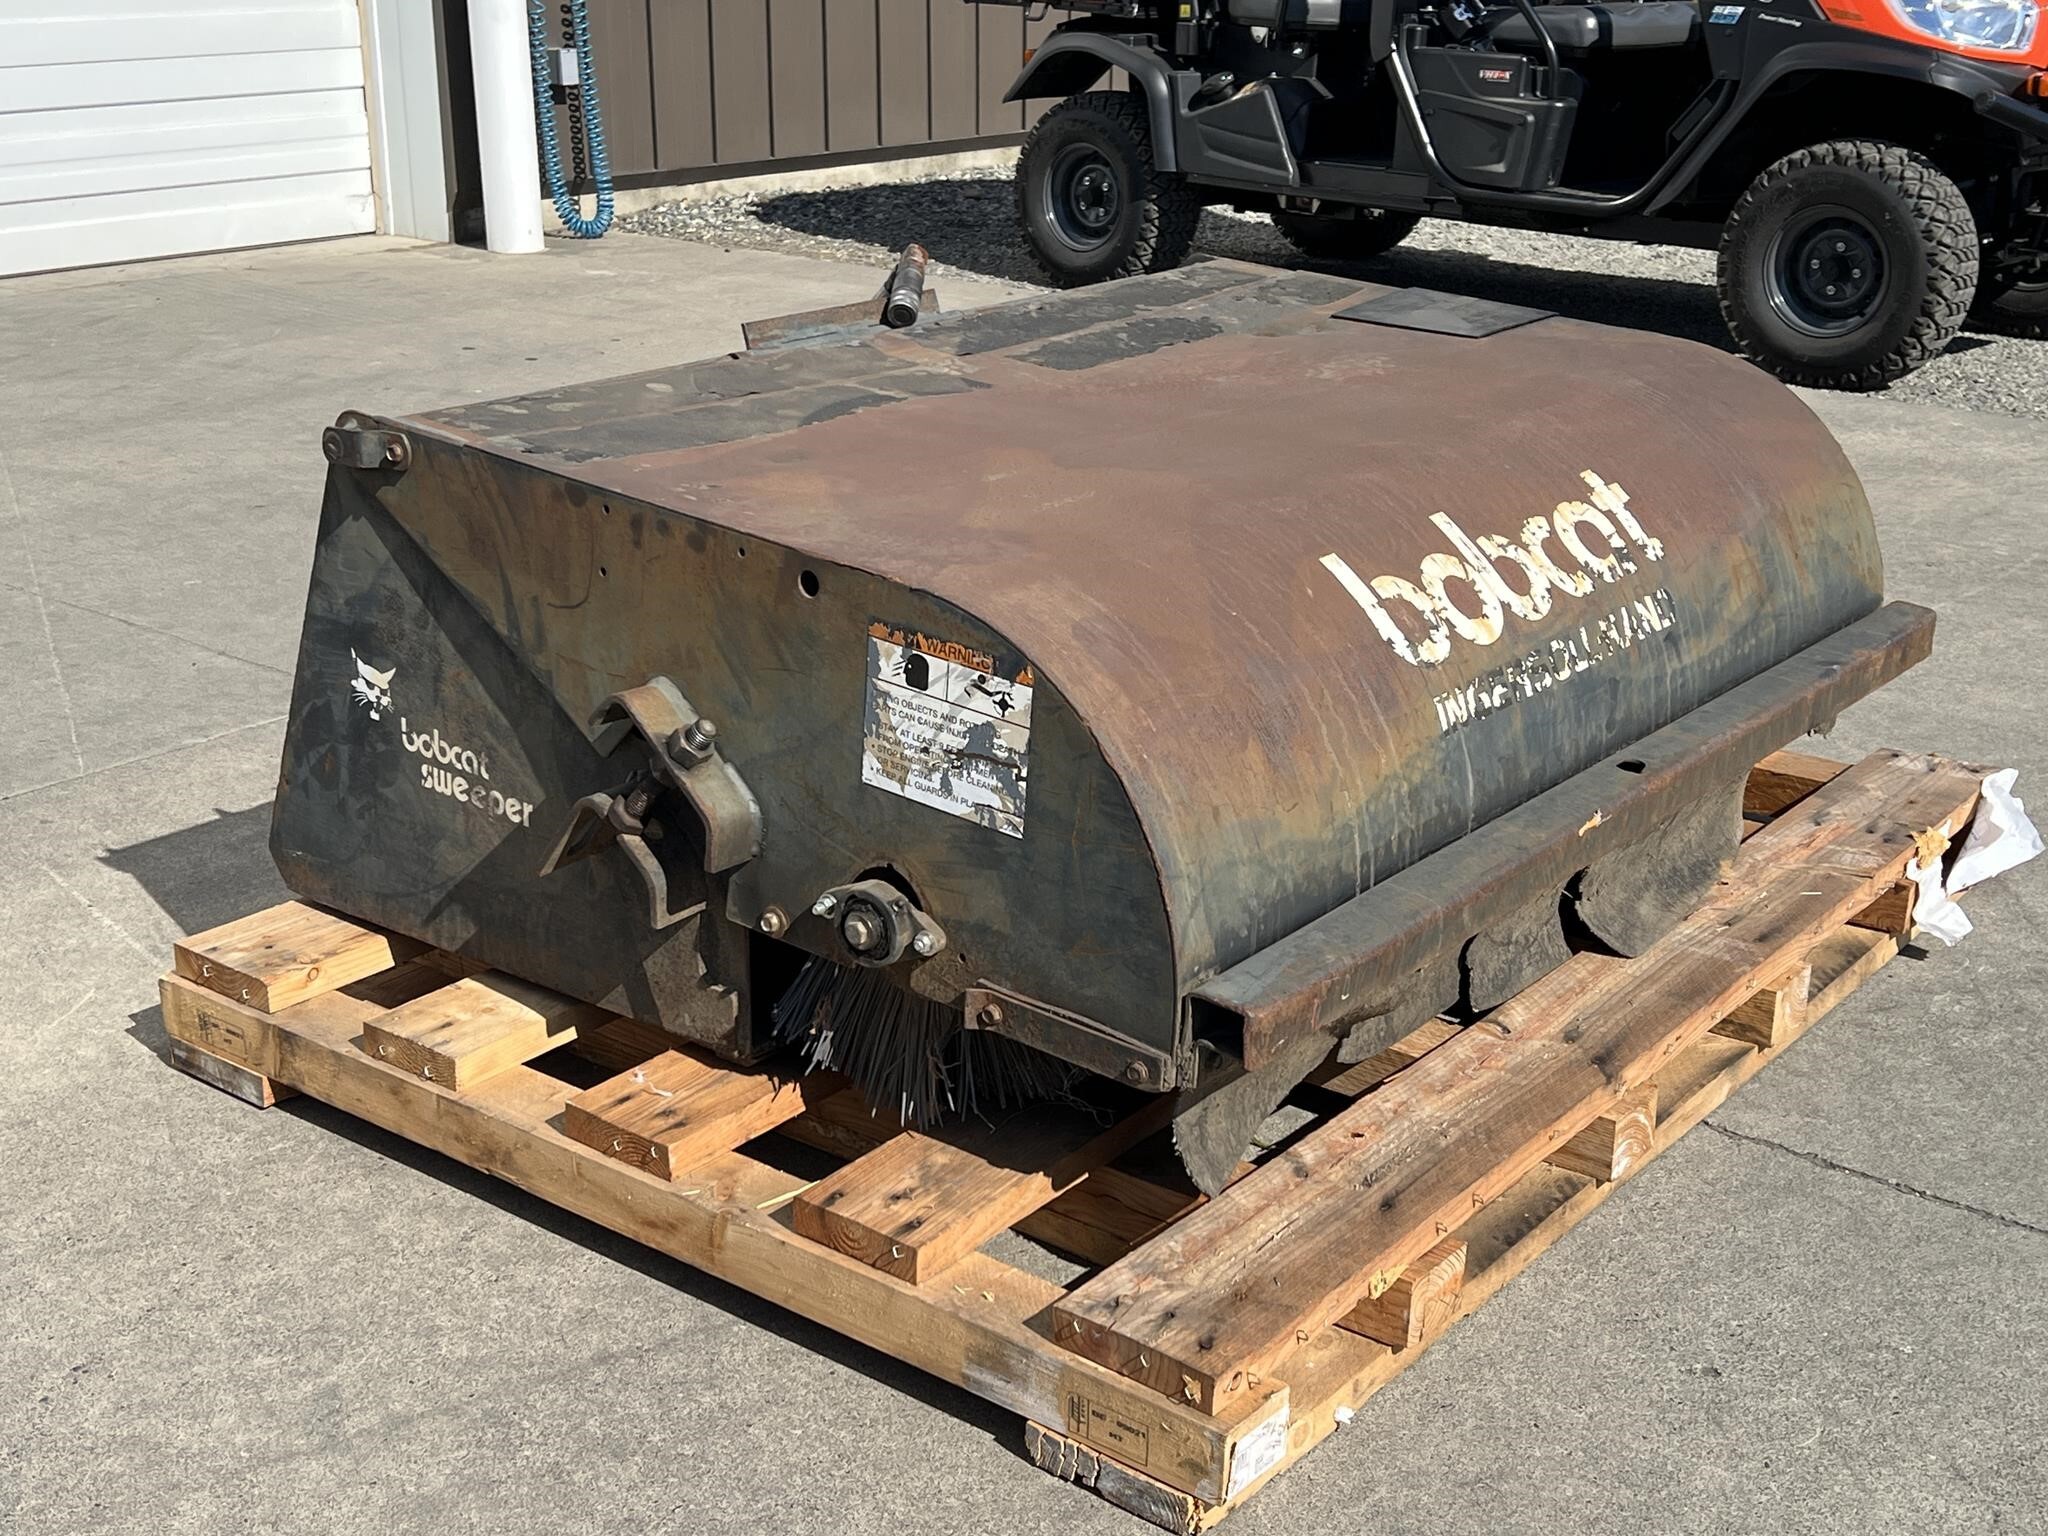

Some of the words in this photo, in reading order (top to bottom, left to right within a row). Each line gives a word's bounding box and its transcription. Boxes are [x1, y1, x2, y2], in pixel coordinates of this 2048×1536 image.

[1319, 469, 1665, 668] bobcat
[898, 710, 915, 722] CAN
[917, 717, 945, 733] CAUSE
[901, 699, 939, 719] OBJECTS
[940, 712, 958, 725] AND
[401, 717, 490, 780] bobcat
[877, 744, 898, 756] STOP
[879, 734, 901, 747] FROM
[900, 729, 911, 738] AT
[912, 733, 937, 747] LEAST
[421, 764, 534, 828] sweeper
[876, 767, 897, 780] KEEP
[914, 780, 949, 799] GUARDS
